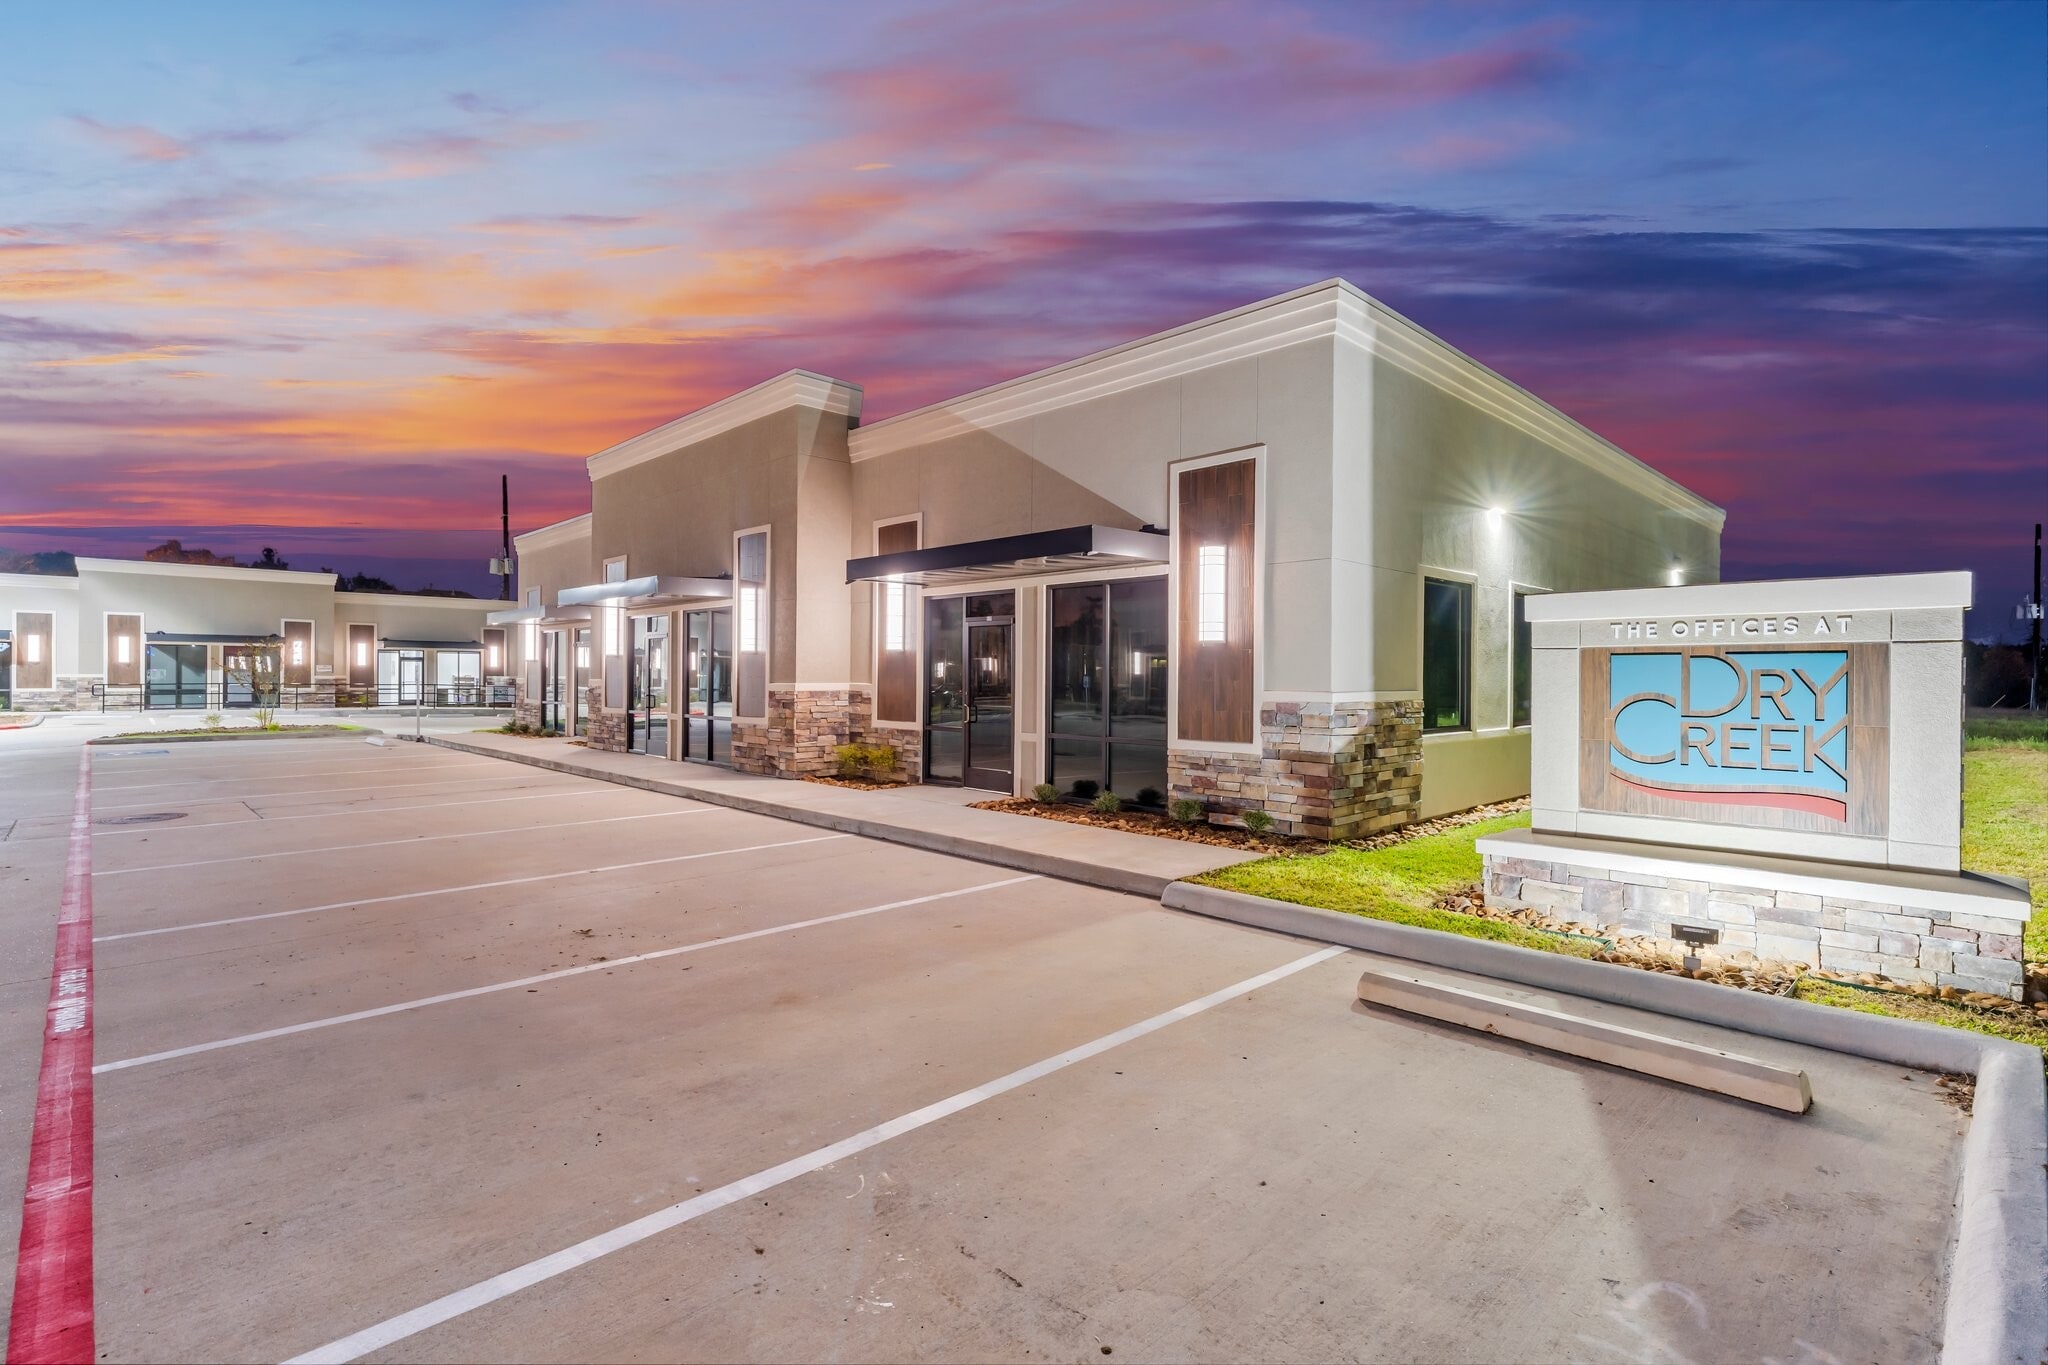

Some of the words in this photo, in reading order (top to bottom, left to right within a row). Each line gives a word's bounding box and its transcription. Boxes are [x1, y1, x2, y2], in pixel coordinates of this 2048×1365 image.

[1609, 620, 1658, 640] THE
[1671, 616, 1799, 638] OFFICES
[1813, 614, 1853, 634] AT
[1681, 650, 1848, 721] DRY
[1606, 692, 1848, 782] CREEK
